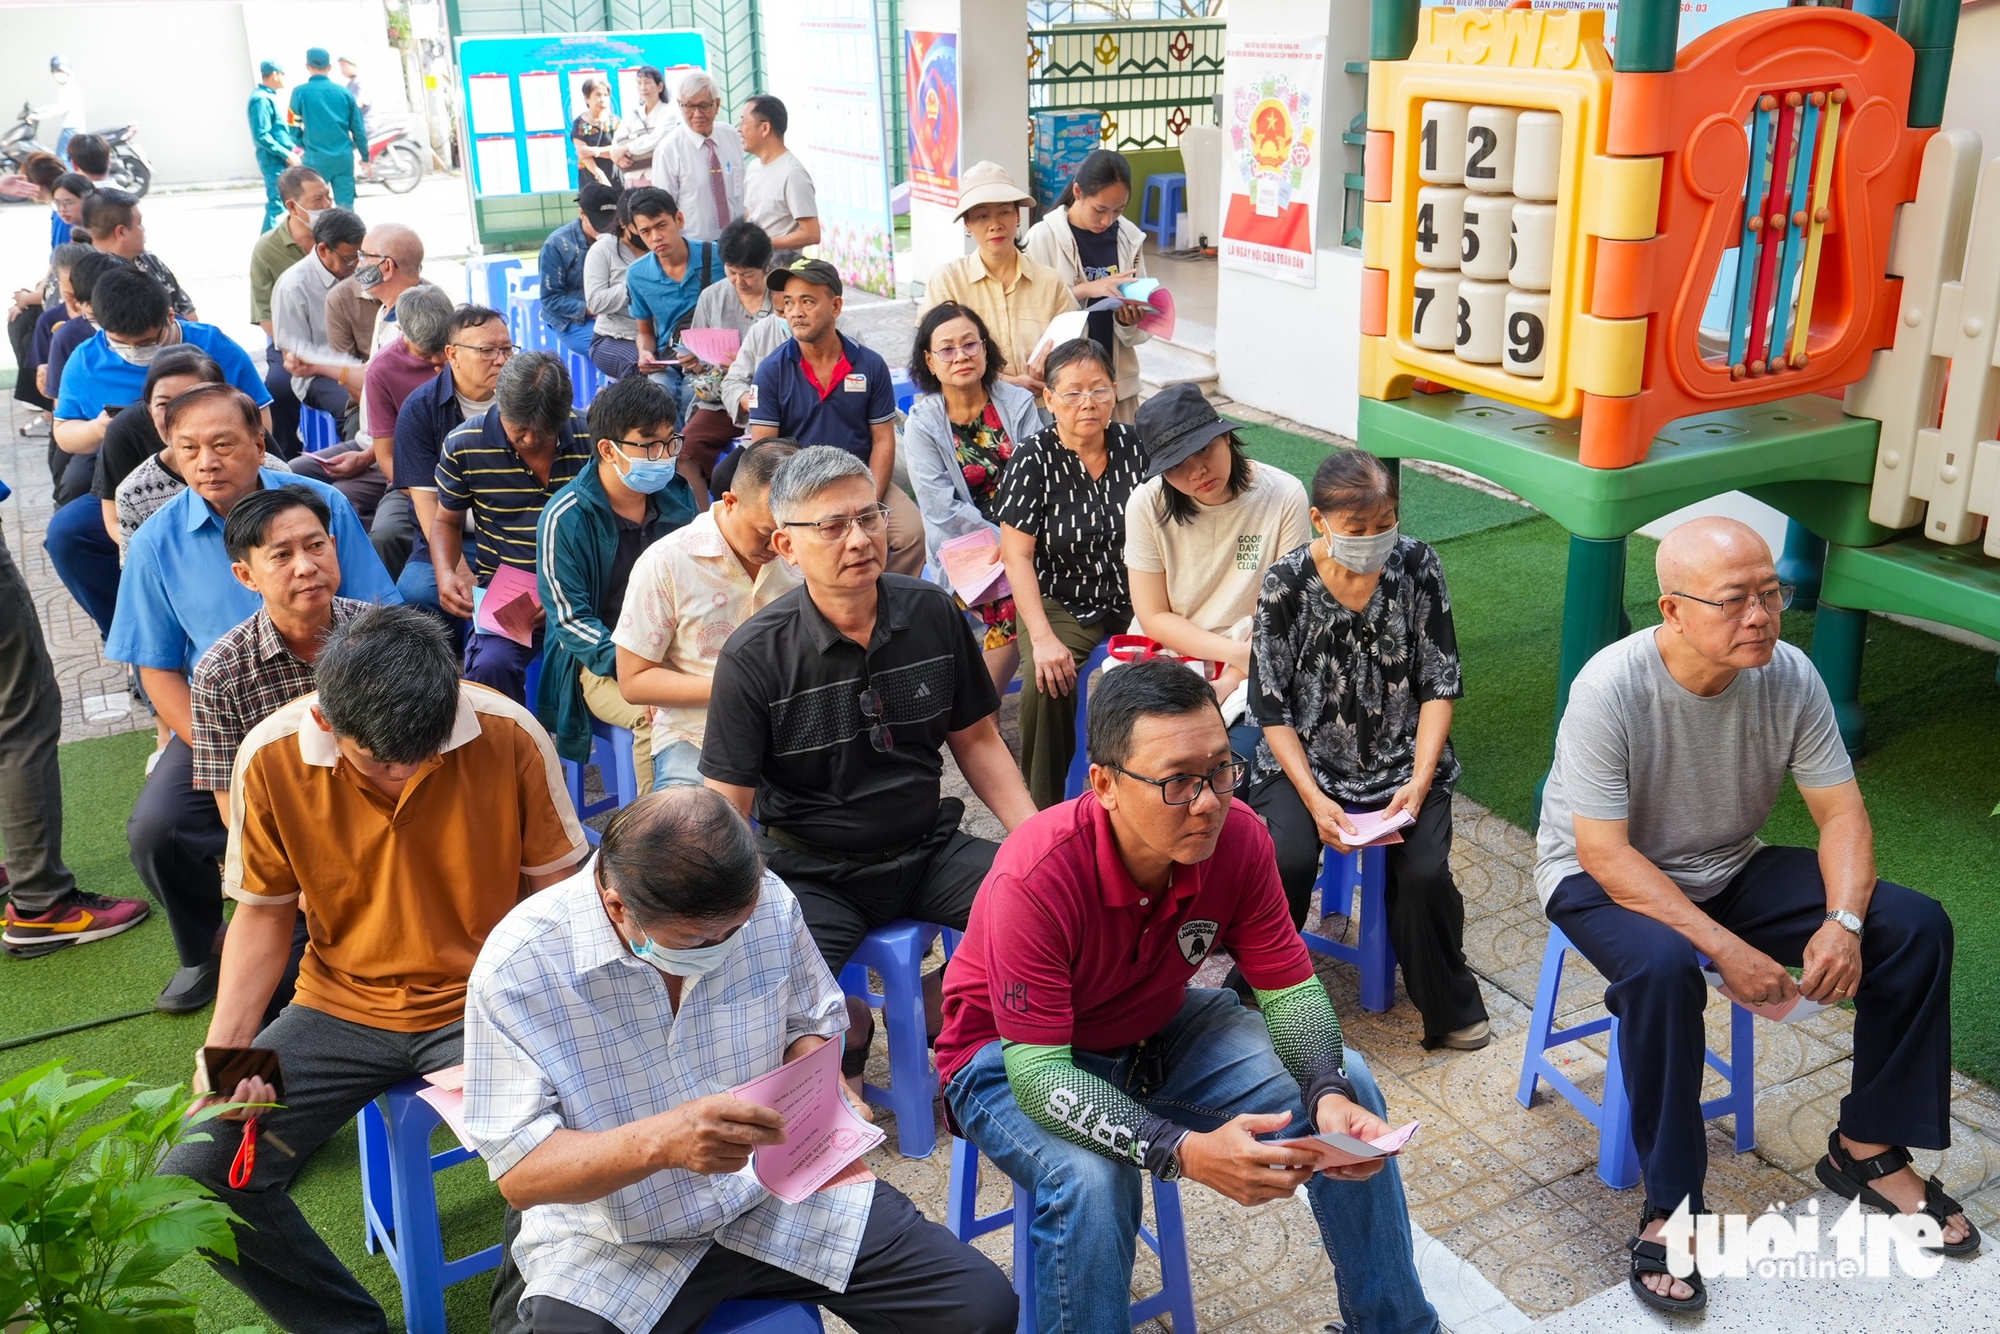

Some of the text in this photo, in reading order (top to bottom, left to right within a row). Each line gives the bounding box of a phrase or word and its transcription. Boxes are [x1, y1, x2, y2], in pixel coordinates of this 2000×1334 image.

[1696, 3, 1708, 13] 03
[1418, 8, 1581, 69] LCWJ
[1421, 119, 1497, 179] 1 2
[1415, 203, 1438, 253] 4
[1461, 212, 1480, 263] 5
[1413, 287, 1435, 334] 7
[1508, 311, 1545, 364] 9
[1238, 535, 1262, 543] GOOD
[1239, 544, 1259, 552] DAYS
[1237, 553, 1259, 561] BOOK
[1238, 562, 1257, 570] CLUB
